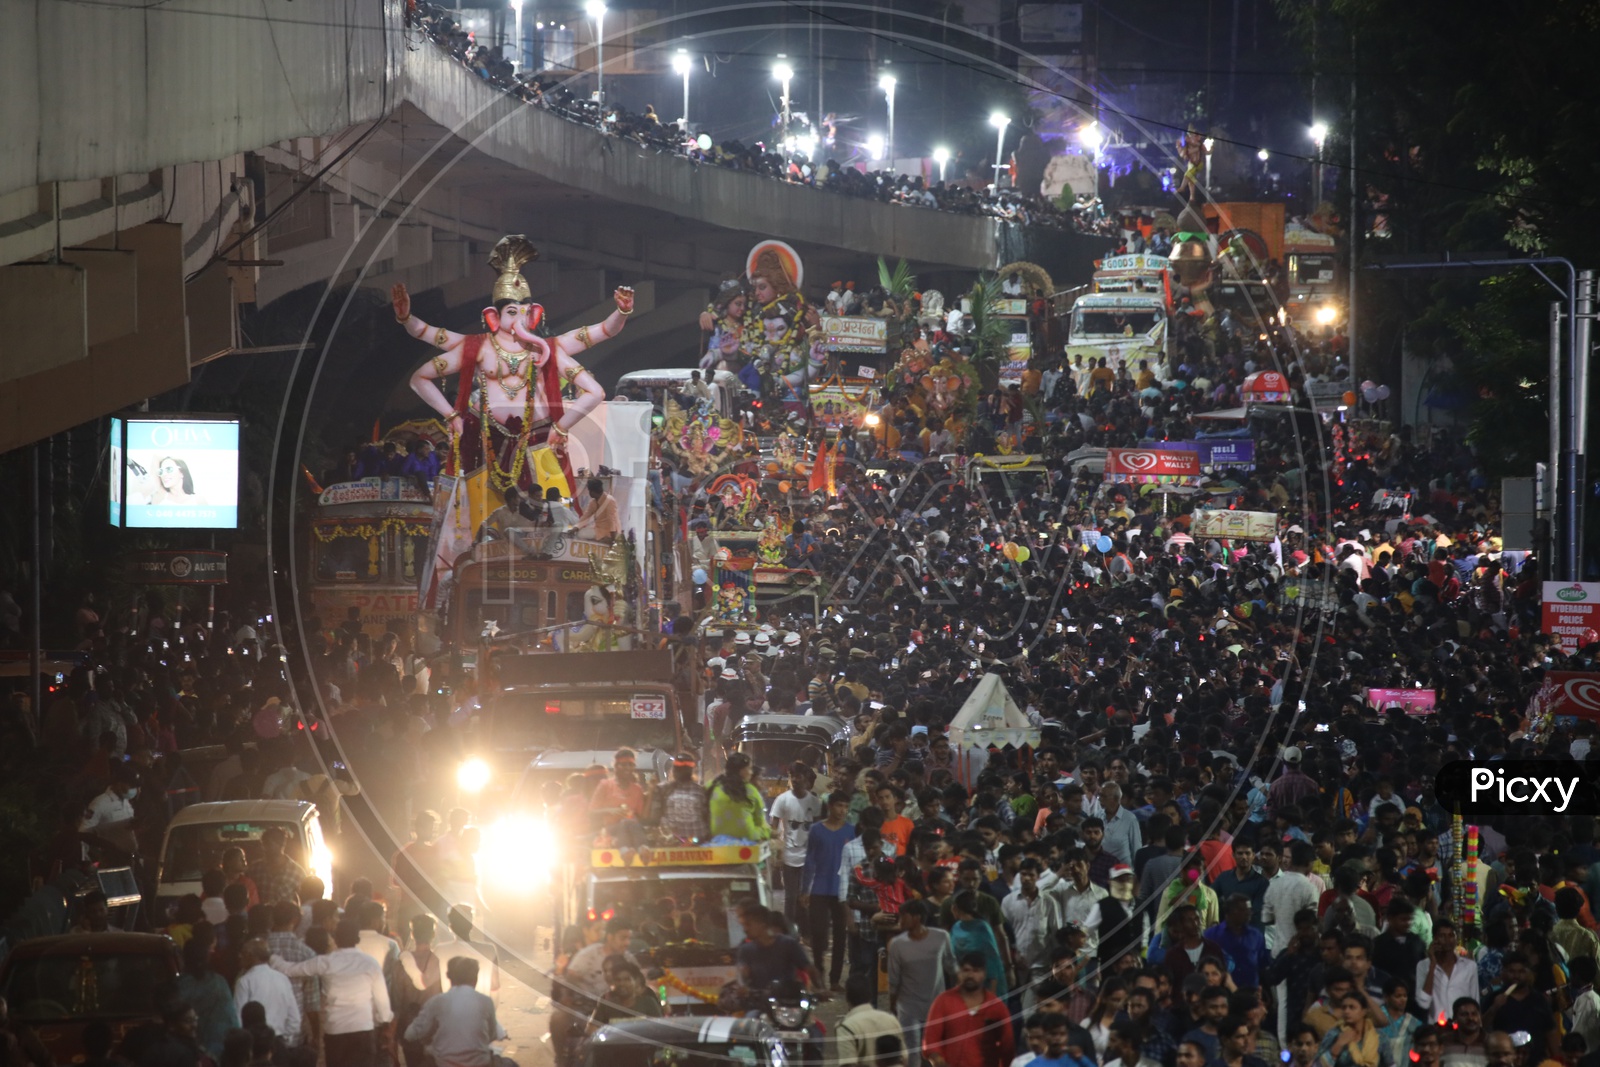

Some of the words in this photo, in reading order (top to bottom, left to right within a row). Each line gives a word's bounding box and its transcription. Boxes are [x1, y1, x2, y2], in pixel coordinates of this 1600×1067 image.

[1107, 257, 1133, 269] GOODS
[1163, 461, 1191, 469] WALL'S
[194, 562, 215, 571] ALIVE
[497, 569, 538, 579] GOODS
[1559, 590, 1585, 598] GHMC
[1550, 604, 1593, 614] HYDERABAD
[1558, 615, 1584, 624] POLICE
[669, 849, 713, 862] BHAVANI
